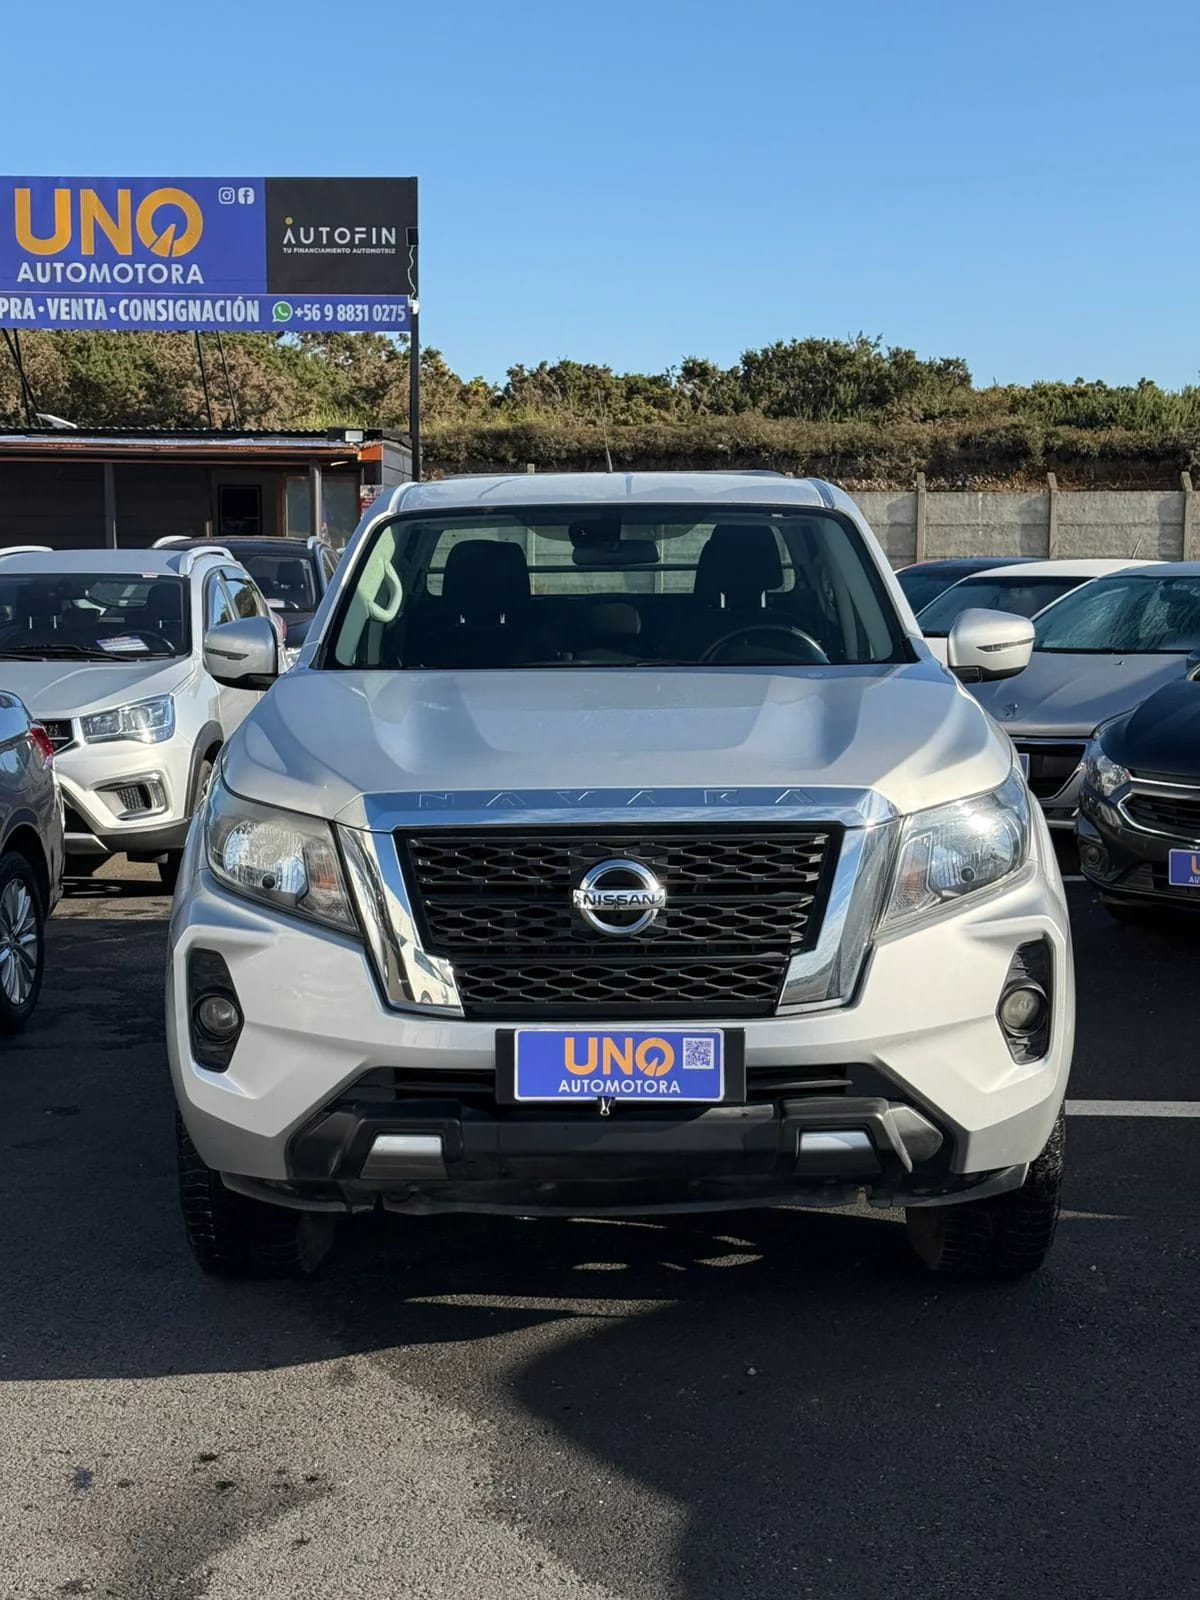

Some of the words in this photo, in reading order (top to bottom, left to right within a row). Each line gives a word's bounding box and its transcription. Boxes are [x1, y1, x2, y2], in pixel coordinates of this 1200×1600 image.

[14, 187, 204, 257] UNO
[282, 226, 396, 245] AUTOFIN
[352, 247, 396, 255] AUTOMOTRIZ
[16, 261, 205, 285] AUTOMOTORA
[46, 298, 108, 321] VENTA
[118, 297, 260, 323] CONSIGNACIÓN
[295, 303, 321, 322] +56
[325, 304, 333, 322] 9
[336, 304, 369, 322] 8831
[372, 304, 407, 322] 0275
[583, 894, 656, 906] NISSAN
[564, 1037, 675, 1077] UNO
[558, 1079, 681, 1093] AUTOMOTORA
